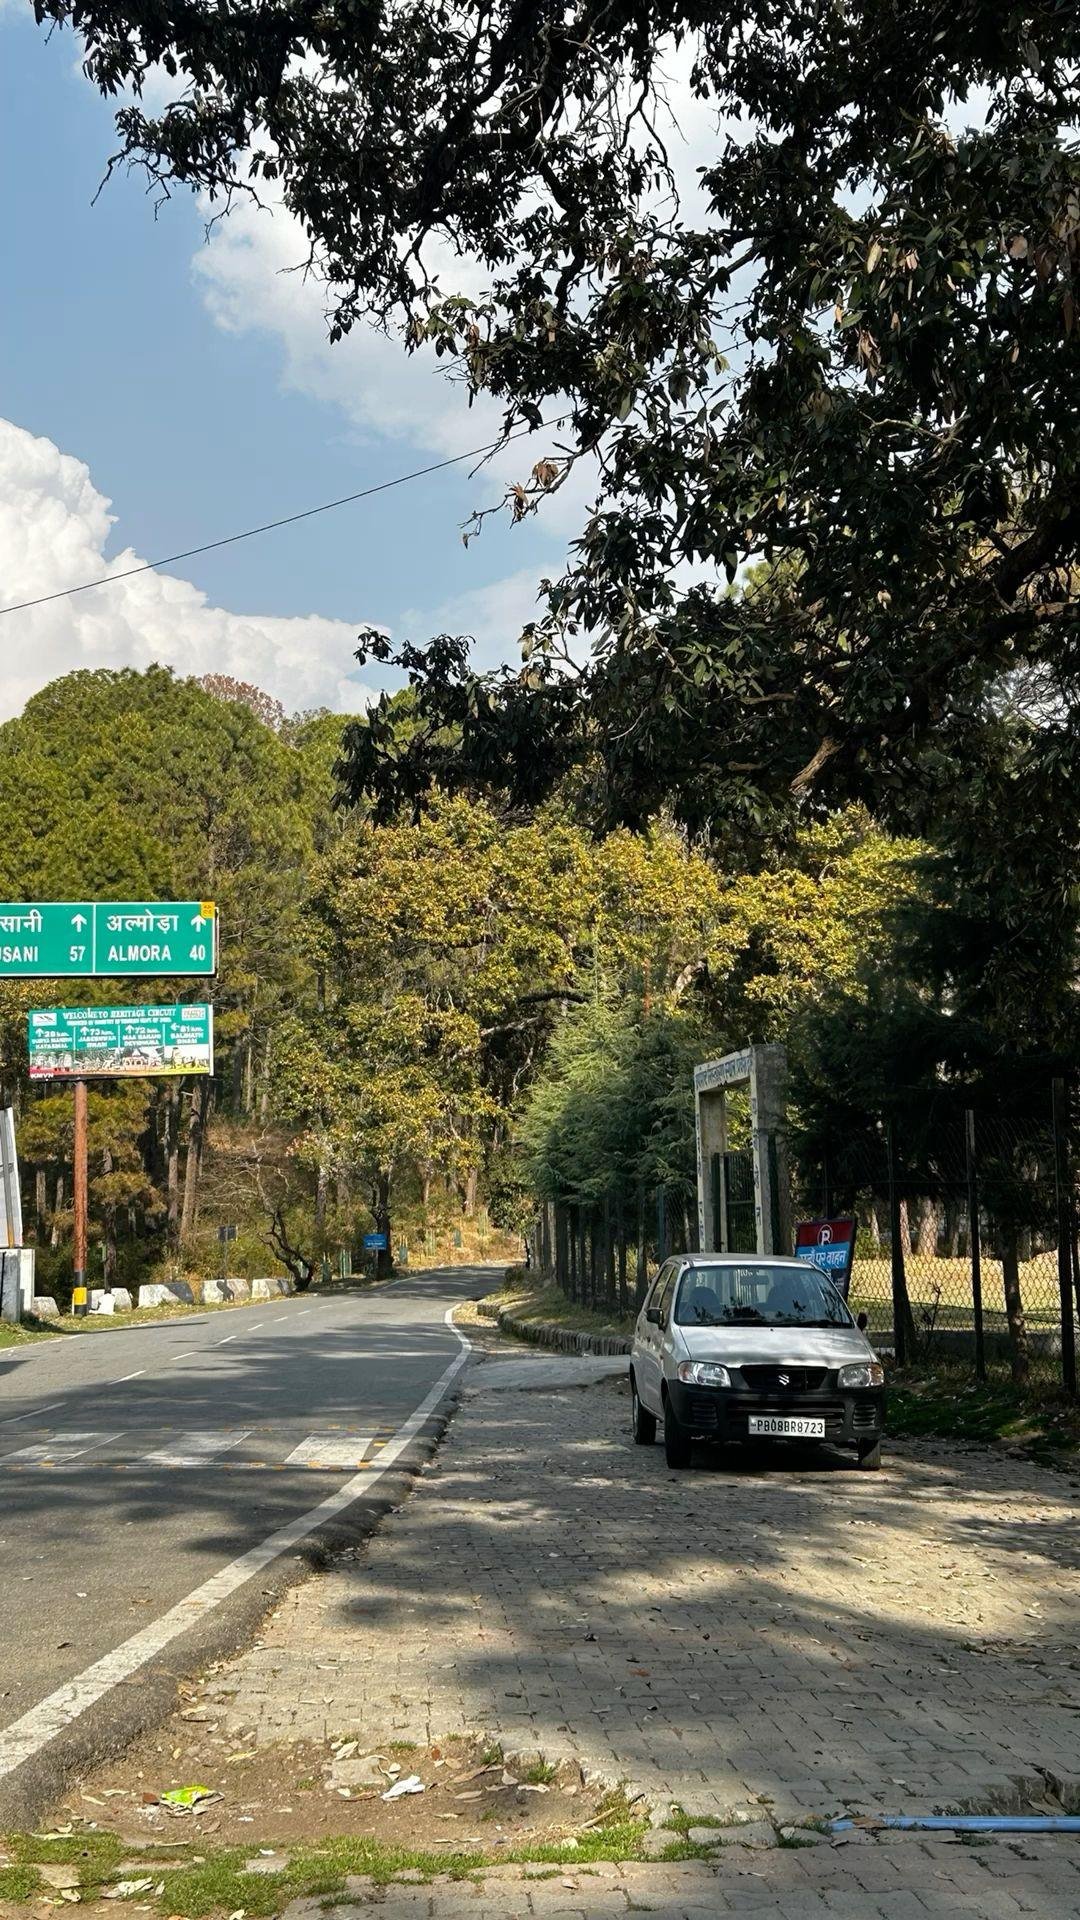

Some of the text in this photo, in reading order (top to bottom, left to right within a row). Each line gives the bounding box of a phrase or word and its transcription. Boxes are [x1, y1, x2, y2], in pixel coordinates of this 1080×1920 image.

[107, 909, 179, 934] अल्मोड़ा
[0, 946, 86, 963] SANI 57
[108, 944, 206, 962] ALMORA 40
[98, 1010, 109, 1019] TO
[148, 1008, 176, 1017] CIRCUIT
[827, 1250, 847, 1268] वाहन
